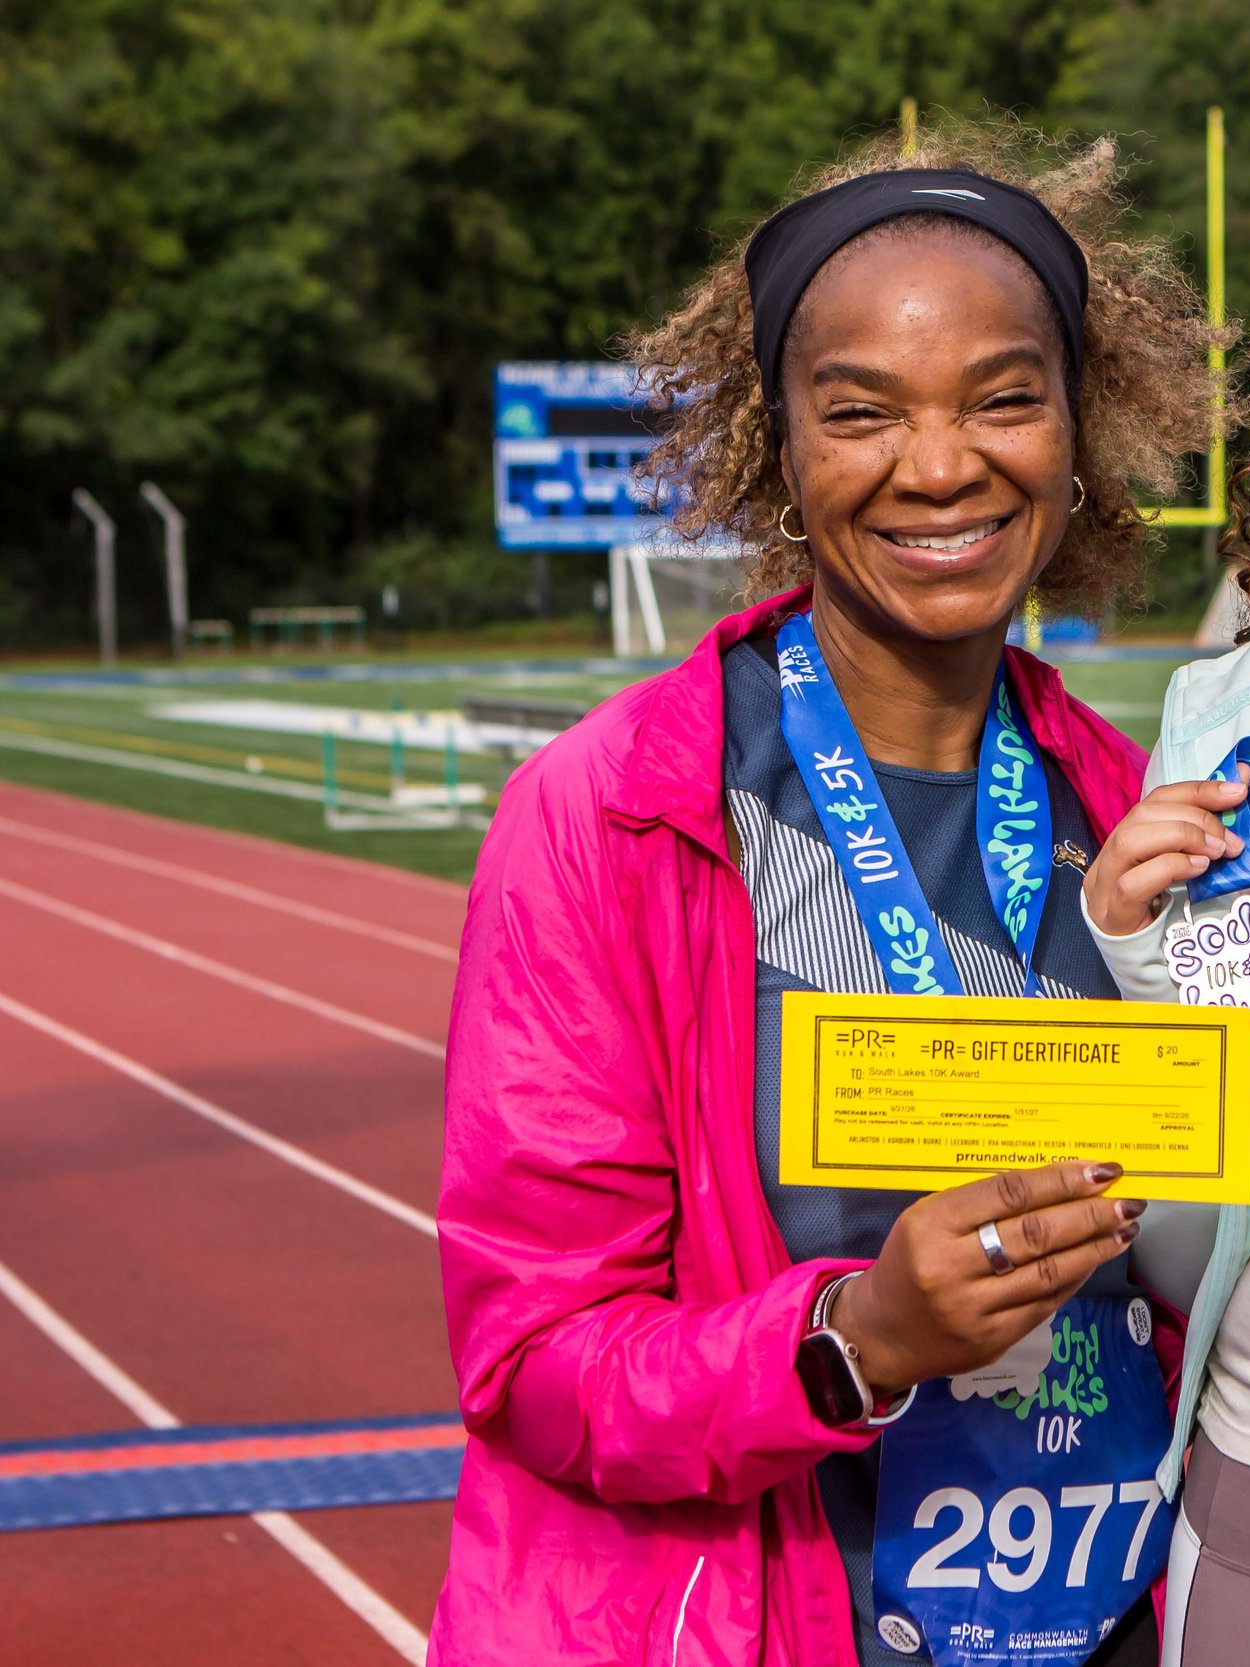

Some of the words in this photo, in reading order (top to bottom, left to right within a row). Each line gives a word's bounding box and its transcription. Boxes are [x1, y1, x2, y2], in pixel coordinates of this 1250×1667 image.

[788, 645, 819, 682] RACES
[989, 681, 1038, 813] SOUTH
[813, 745, 864, 792] 5K
[827, 795, 878, 823] &
[846, 825, 899, 884] 10K
[988, 820, 1043, 943] LAKES
[879, 906, 944, 996] KES
[972, 1040, 1009, 1061] GIFT
[1013, 1042, 1121, 1064] CERTIFICATE
[1157, 1046, 1163, 1058] $
[1166, 1046, 1178, 1054] 20
[851, 1068, 865, 1080] TO:
[868, 1067, 895, 1076] South
[899, 1068, 926, 1077] Lakes
[930, 1069, 948, 1077] 10K
[950, 1070, 980, 1078] Award
[835, 1087, 864, 1099] FROM:
[868, 1087, 882, 1096] PR
[885, 1088, 914, 1097] Races
[956, 1151, 1079, 1163] prrunandwalk.com
[1052, 1316, 1099, 1374] UTH
[1037, 1416, 1082, 1454] 10K
[907, 1480, 1163, 1593] 2977
[1008, 1640, 1032, 1650] RACE
[1033, 1637, 1087, 1648] MANAGEMENT
[1009, 1629, 1089, 1641] COMMONWEALTH
